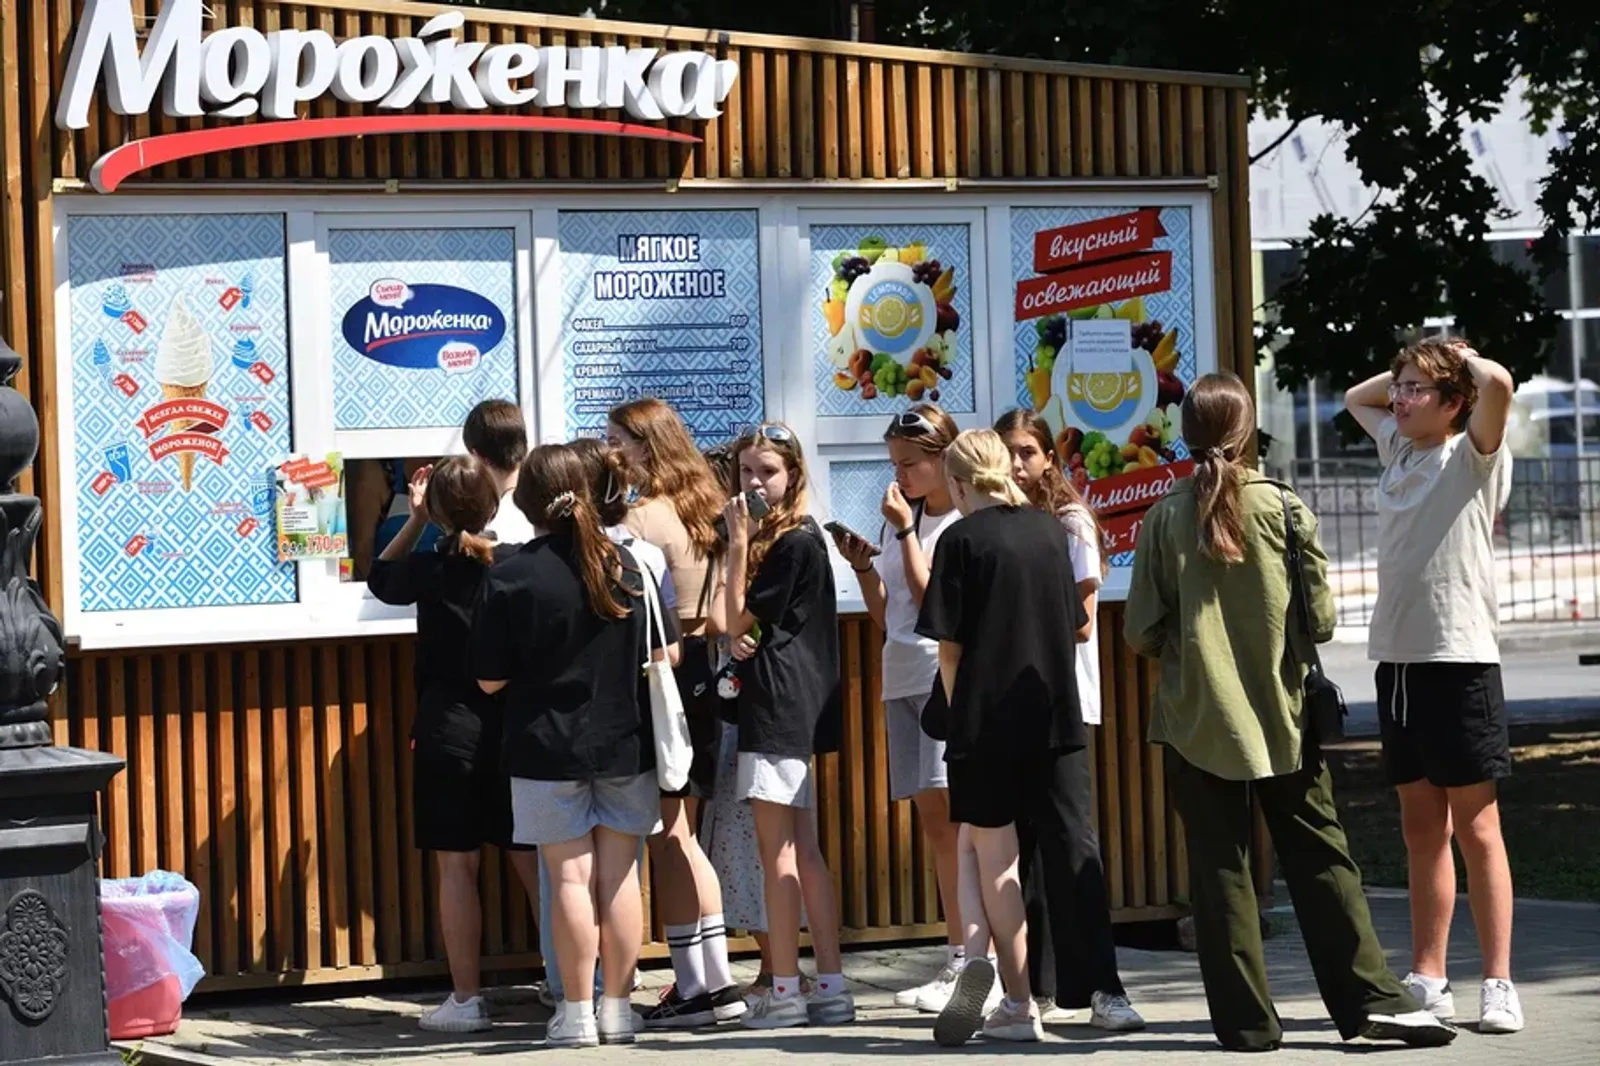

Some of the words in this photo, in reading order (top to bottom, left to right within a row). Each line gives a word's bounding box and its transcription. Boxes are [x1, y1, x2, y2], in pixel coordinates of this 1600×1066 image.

[55, 0, 739, 132] Мороженка
[618, 233, 700, 263] МЯГКОЕ
[1048, 217, 1139, 261] вкусный
[594, 269, 726, 299] МОРОЖЕНОЕ
[1022, 259, 1161, 310] освежающий
[364, 309, 492, 343] Мороженка
[573, 338, 623, 355] САХАРНЫЙ
[574, 363, 622, 378] КРЕМАНКА
[574, 387, 623, 401] КРЕМАНКА
[641, 383, 695, 398] ПОСЫПКОЙ
[717, 383, 751, 397] ВЫБОР
[149, 406, 185, 422] ВСЕГДА
[186, 404, 225, 421] СВЕЖЕЕ
[154, 438, 218, 454] МОРОЖЕНОЕ
